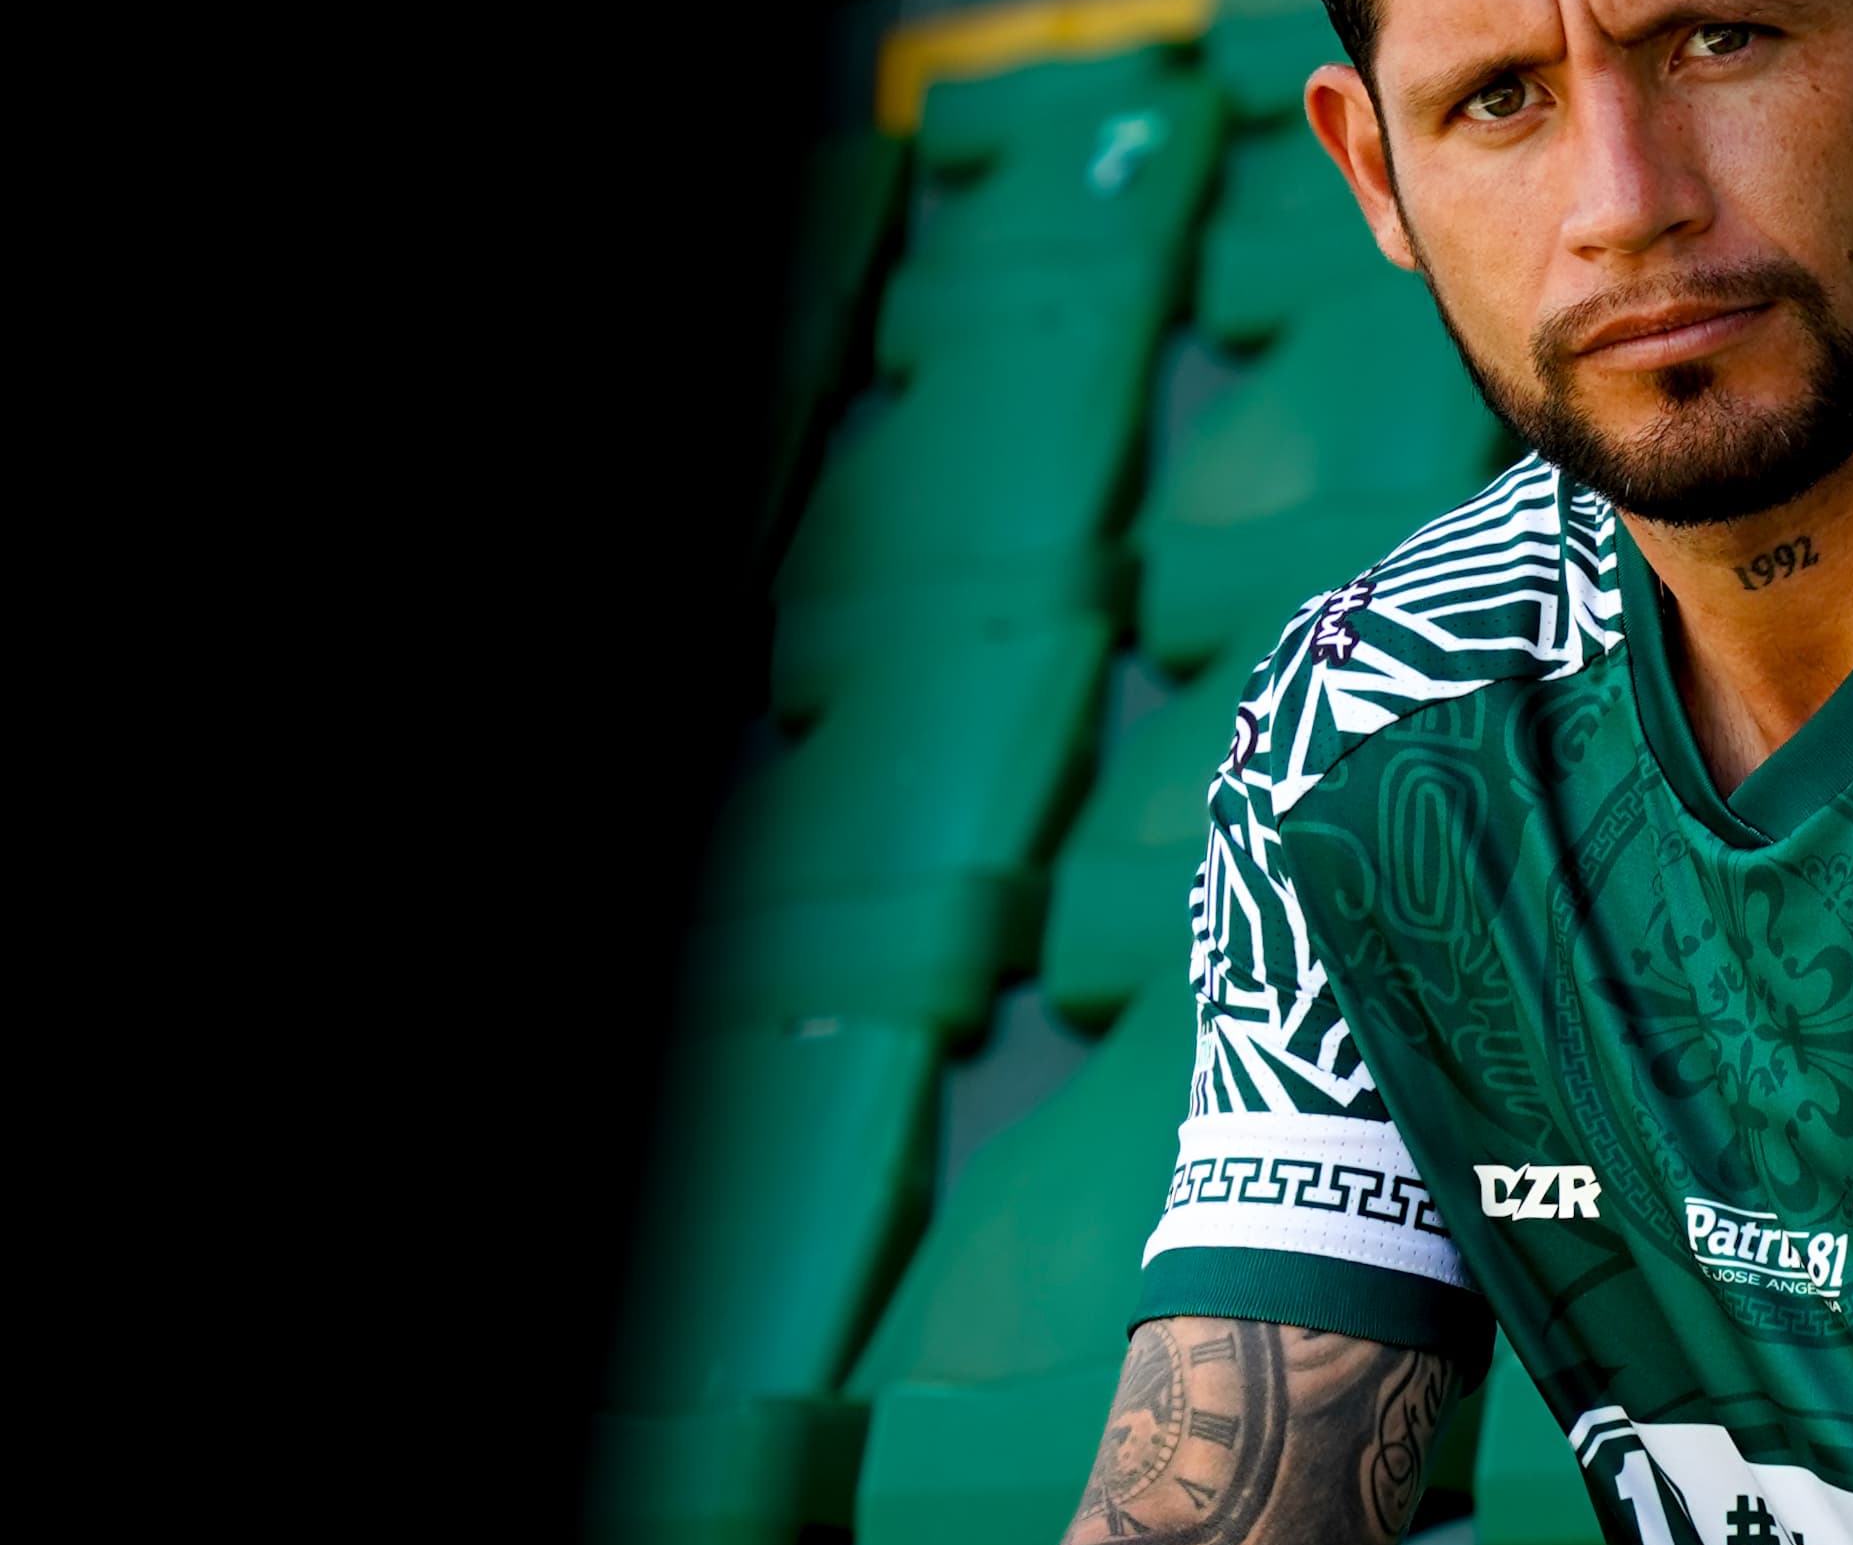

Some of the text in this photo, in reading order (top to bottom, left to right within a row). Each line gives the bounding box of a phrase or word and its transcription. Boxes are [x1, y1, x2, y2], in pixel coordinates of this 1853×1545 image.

[1731, 535, 1819, 590] 1992
[1472, 1162, 1602, 1222] DZR
[1712, 1268, 1761, 1286] JOSE
[1807, 1232, 1848, 1287] 81
